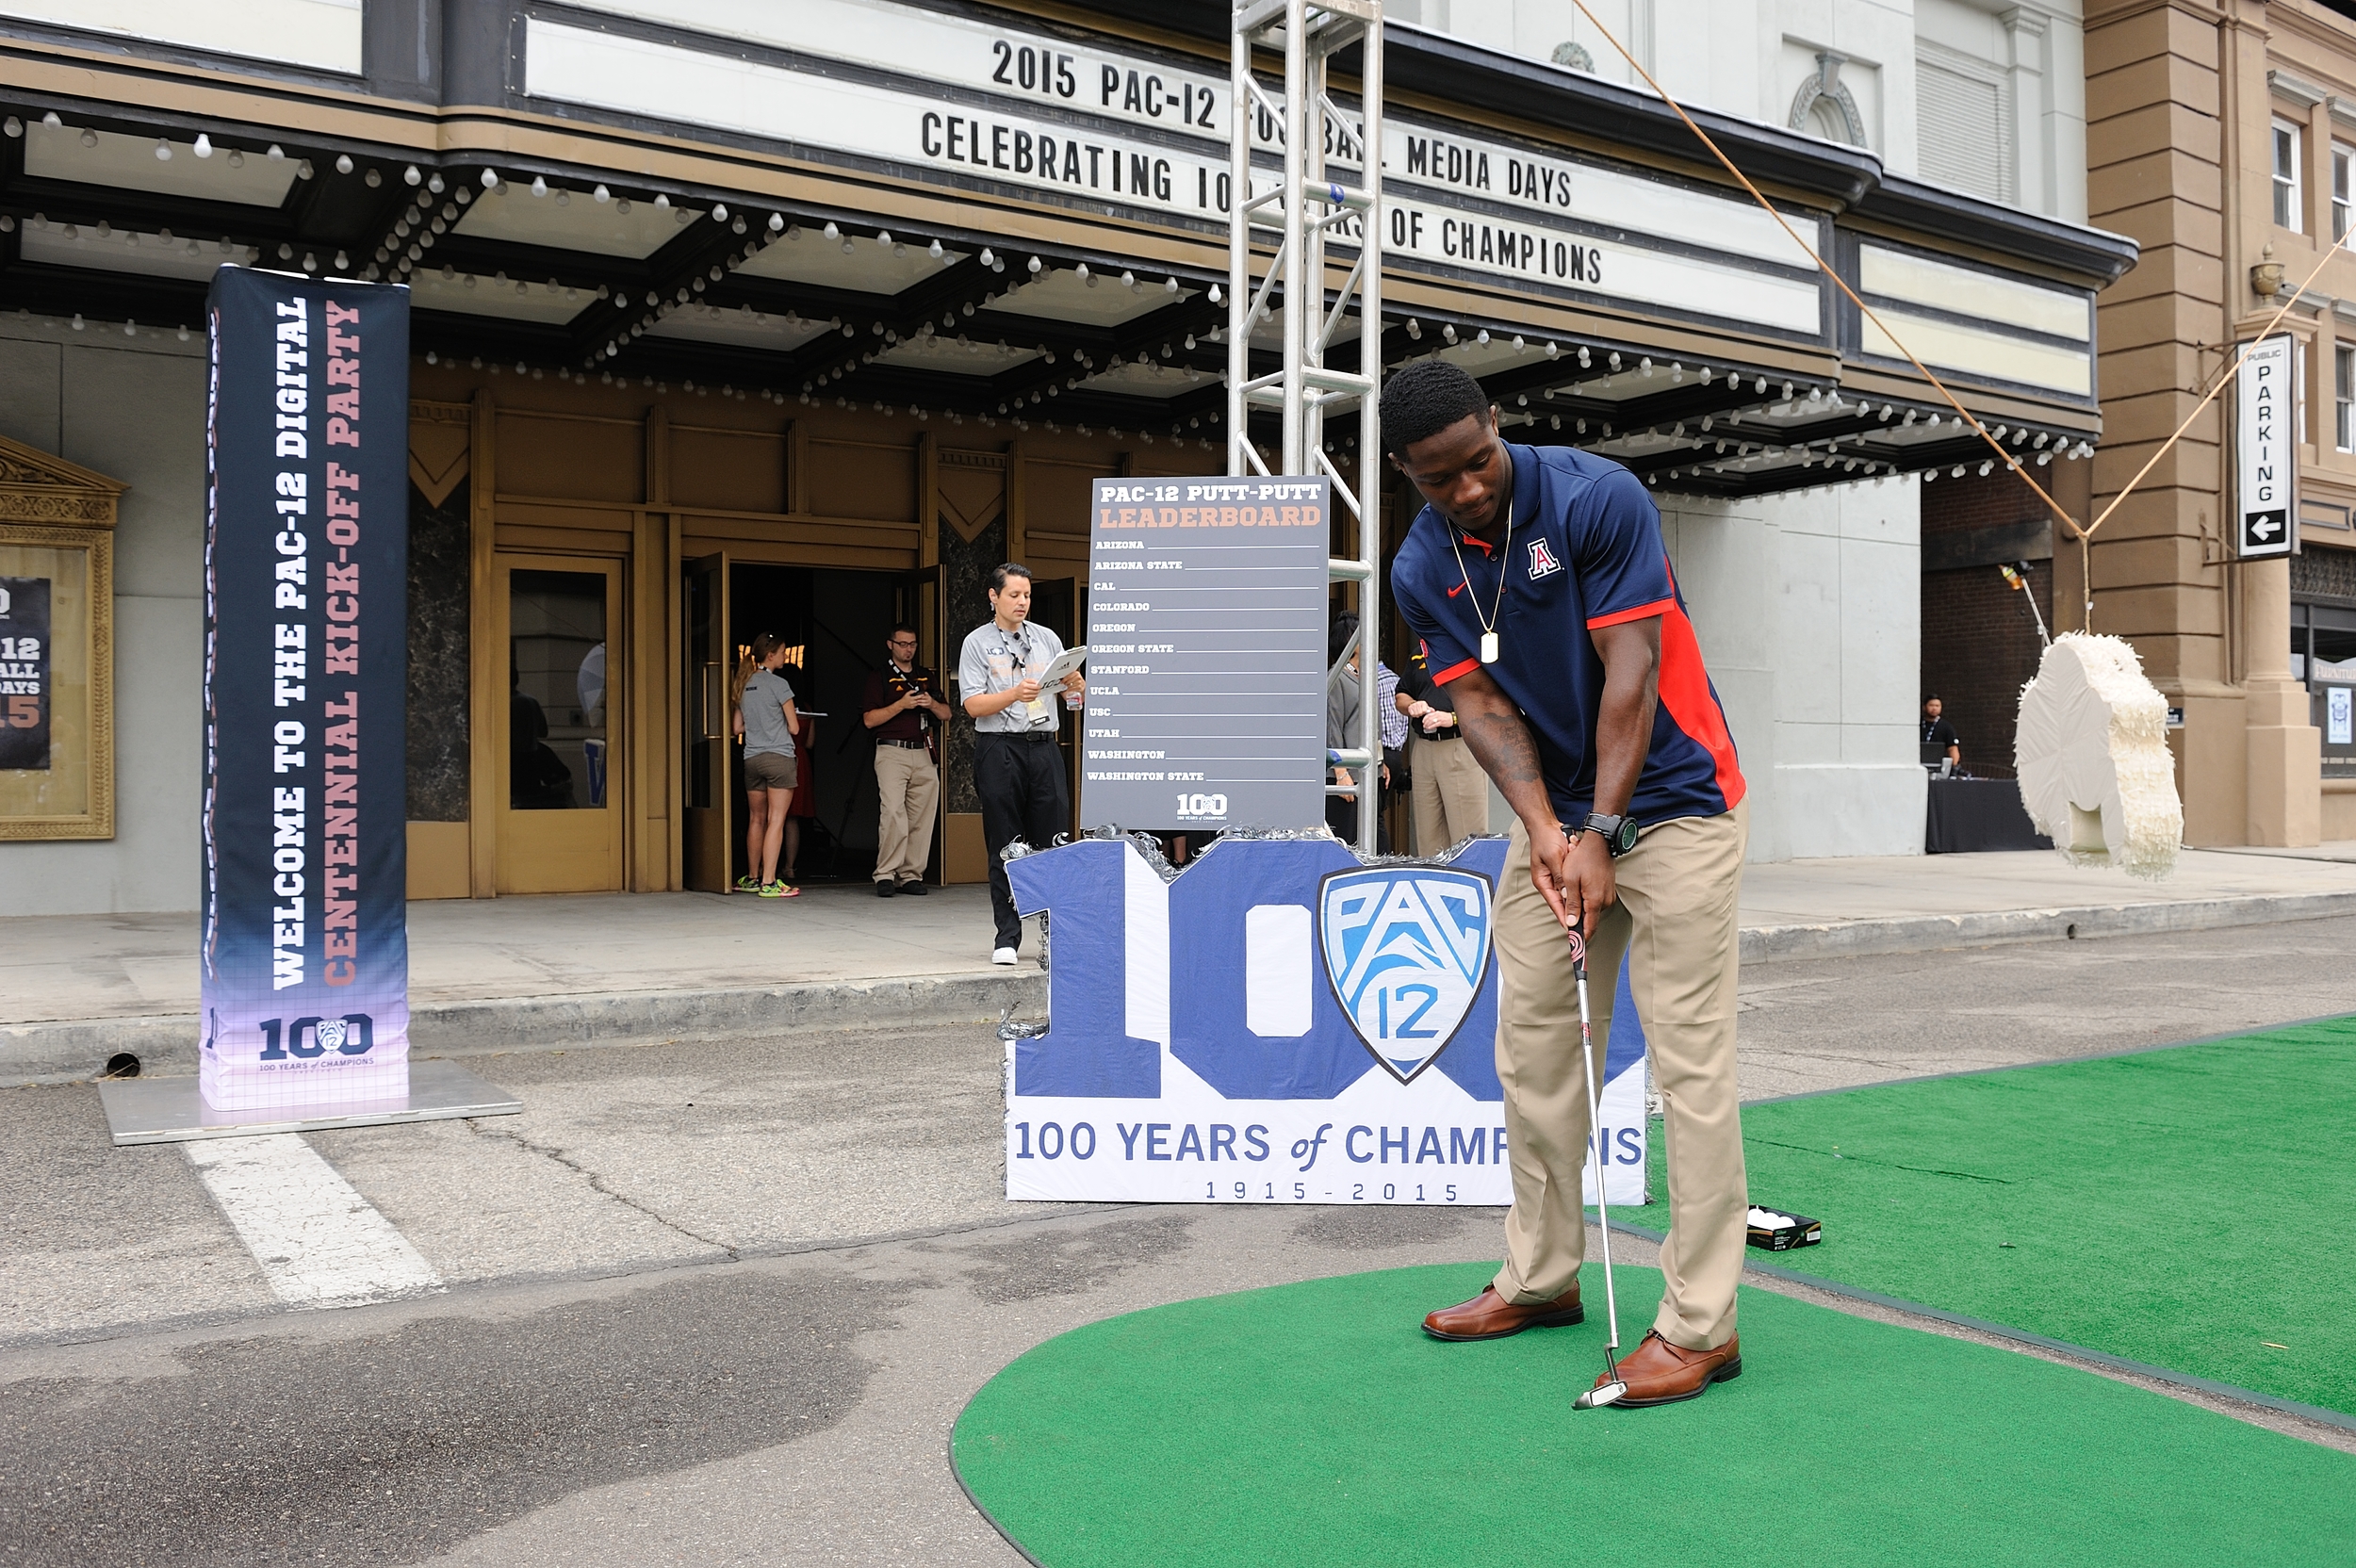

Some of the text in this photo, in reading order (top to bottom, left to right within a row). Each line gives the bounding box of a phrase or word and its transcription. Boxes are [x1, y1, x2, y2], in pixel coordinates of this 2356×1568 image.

[992, 40, 1076, 98] 2015
[1102, 63, 1216, 129] PAC-12
[1408, 136, 1490, 190] MEDIA
[1509, 158, 1571, 207] DAYS
[922, 112, 1171, 202] CELEBRATING
[1199, 167, 1252, 213] 10
[1392, 208, 1423, 249] OF
[1443, 219, 1601, 284] CHAMPIONS
[2248, 350, 2282, 362] PUBLIC
[2257, 365, 2273, 501] PARKING
[1100, 484, 1322, 503] PAC-12 PUTT-PUTT
[1099, 506, 1321, 529] LEADERBOARD
[1095, 541, 1145, 549] ARIZONA
[1527, 537, 1562, 580] A
[1094, 561, 1183, 570] ARIZONA STATE
[1093, 582, 1116, 591] CAL
[1092, 603, 1150, 612] COLORADO
[1091, 624, 1137, 632] OREGON
[273, 297, 308, 990] WELCOME TO THE PAC-12 DIGITAL
[323, 300, 360, 987] CENTENNIAL KICK-OFF PARTY
[1091, 645, 1174, 653] OREGON STATE
[1090, 665, 1150, 675] STANFORD
[0, 681, 41, 694] AYS
[1089, 687, 1120, 695] UCLA
[1089, 708, 1111, 716] USC
[1088, 729, 1121, 738] UTAH
[1088, 750, 1165, 760] WASHINGTON
[1087, 772, 1204, 781] WASHINGTON STATE
[1332, 876, 1484, 1001] PAC
[1378, 984, 1439, 1039] 12
[279, 1062, 308, 1070] YEARS
[320, 1057, 374, 1068] CHAMPIONS
[1015, 1121, 1096, 1160] 100
[1117, 1122, 1270, 1162] YEARS
[1290, 1123, 1333, 1172] of
[1206, 1181, 1457, 1201] 1915-2015
